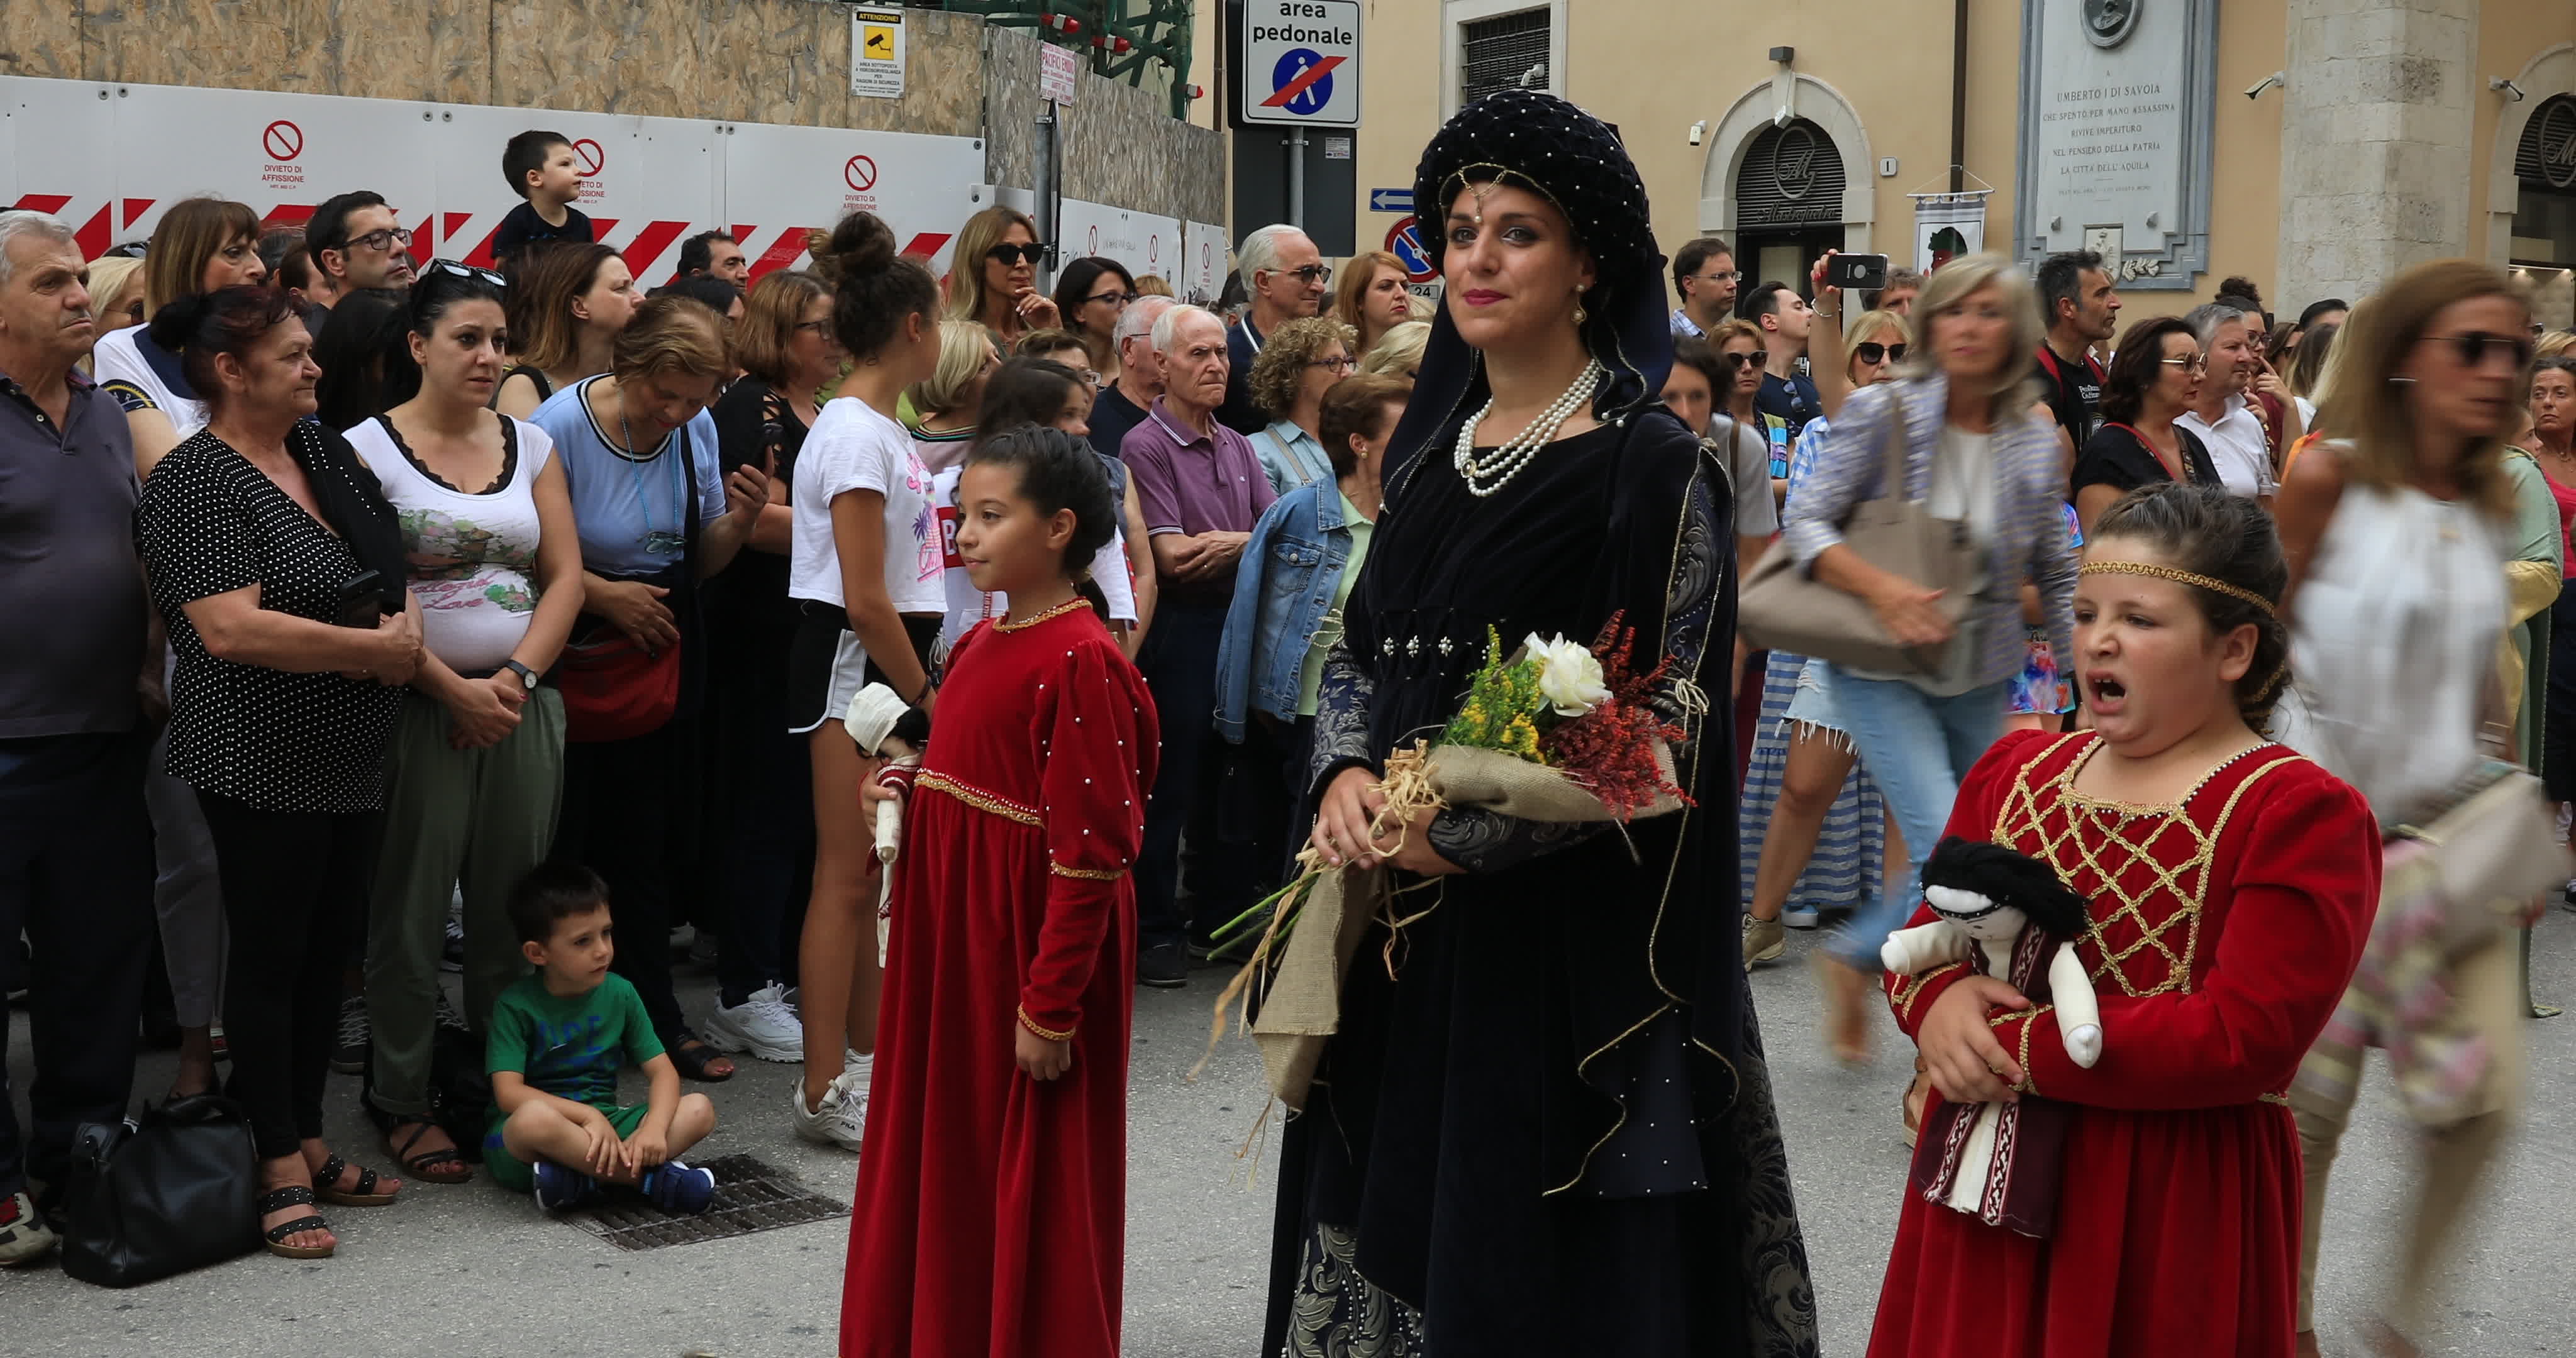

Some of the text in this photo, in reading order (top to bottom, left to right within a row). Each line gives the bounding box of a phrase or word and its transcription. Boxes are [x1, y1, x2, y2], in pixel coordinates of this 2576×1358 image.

[859, 13, 899, 21] ATTENZIONE!
[1280, 3, 1326, 18] area
[1253, 24, 1352, 45] pedonale
[2057, 89, 2101, 102] UMBERTO
[2111, 87, 2121, 97] DI
[2125, 84, 2160, 96] SAVOIA
[2043, 103, 2175, 121] CHE SPENTO PER MANO ASSASSINA
[2072, 125, 2142, 138] RIVIVE IMPERITURO
[2053, 141, 2160, 157] NEL PENSIERO DELLA PATRIA
[265, 165, 293, 173] DIVIETO
[2061, 166, 2069, 175] LA
[2121, 162, 2150, 171] AQUILA
[262, 174, 305, 182] AFFISSIONE
[1414, 287, 1431, 297] 24
[840, 1121, 855, 1131] FILA
